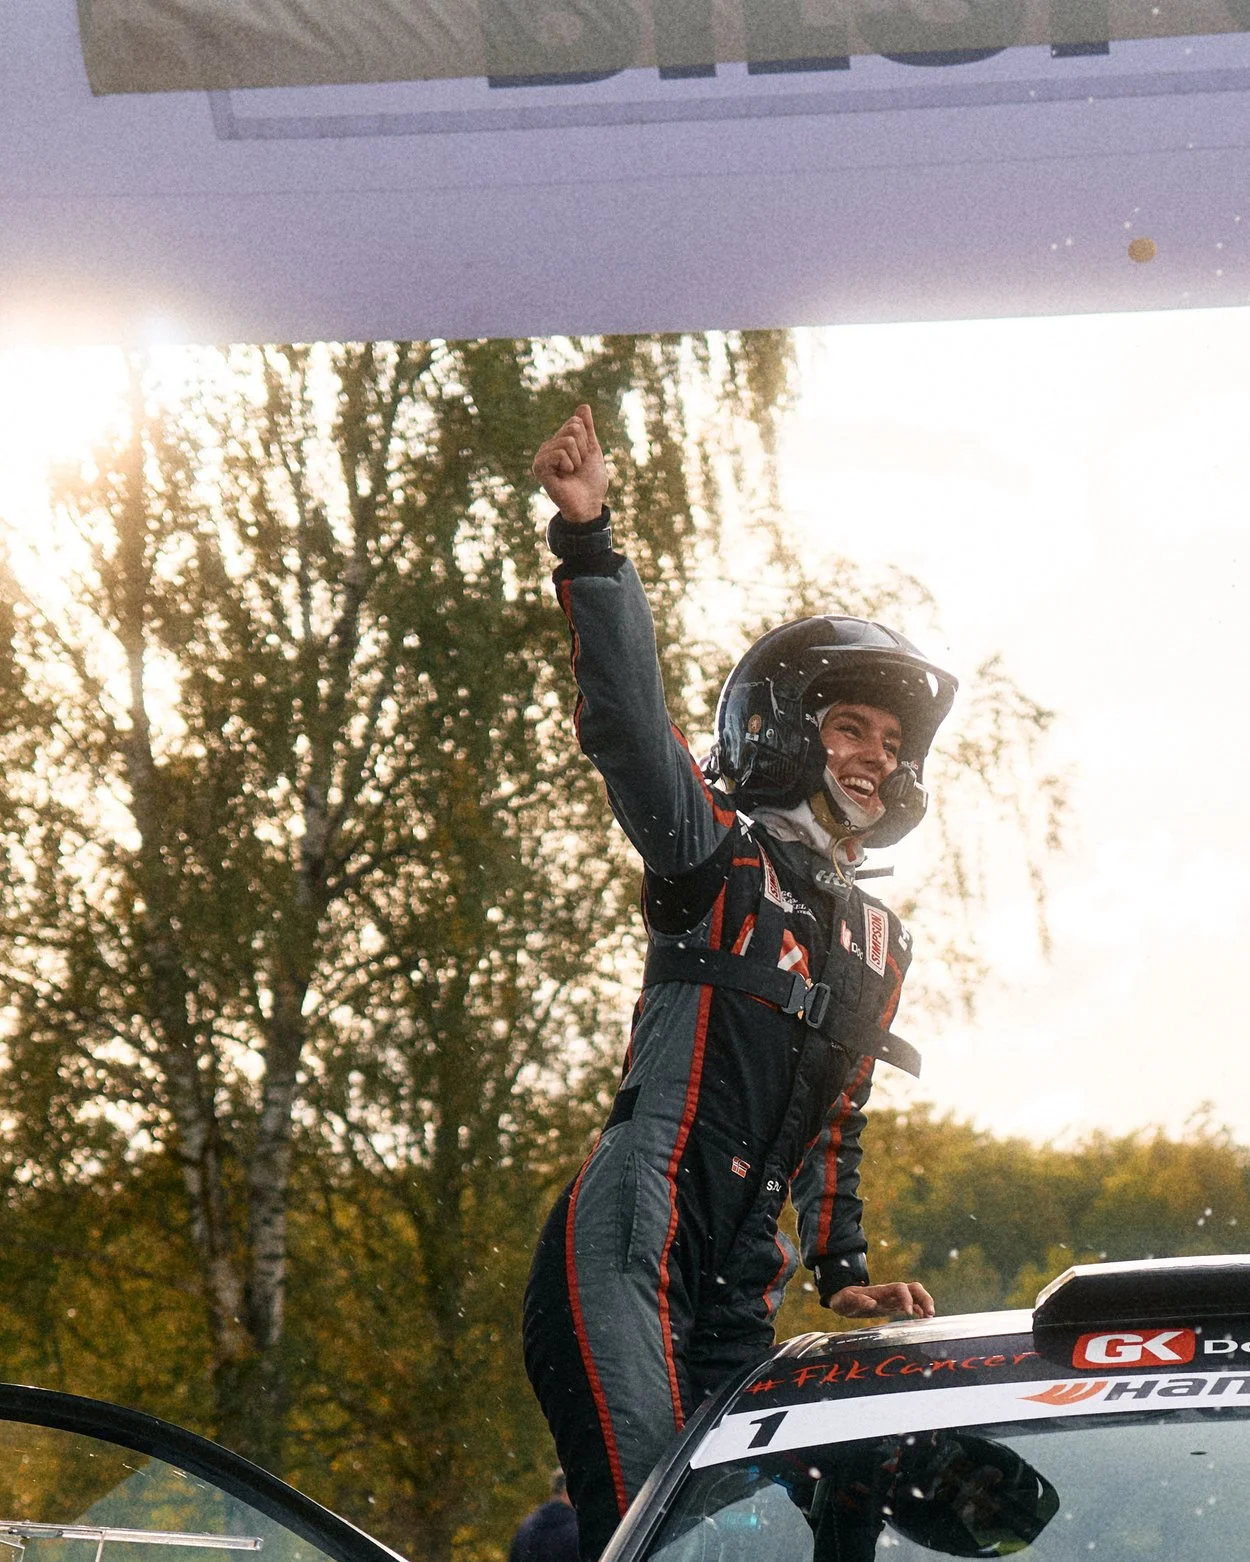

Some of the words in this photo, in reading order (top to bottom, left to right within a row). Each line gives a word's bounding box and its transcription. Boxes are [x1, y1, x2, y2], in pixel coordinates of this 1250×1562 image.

[871, 913, 882, 971] SIMPSON
[1084, 1331, 1185, 1364] GK
[747, 1410, 789, 1449] 1
